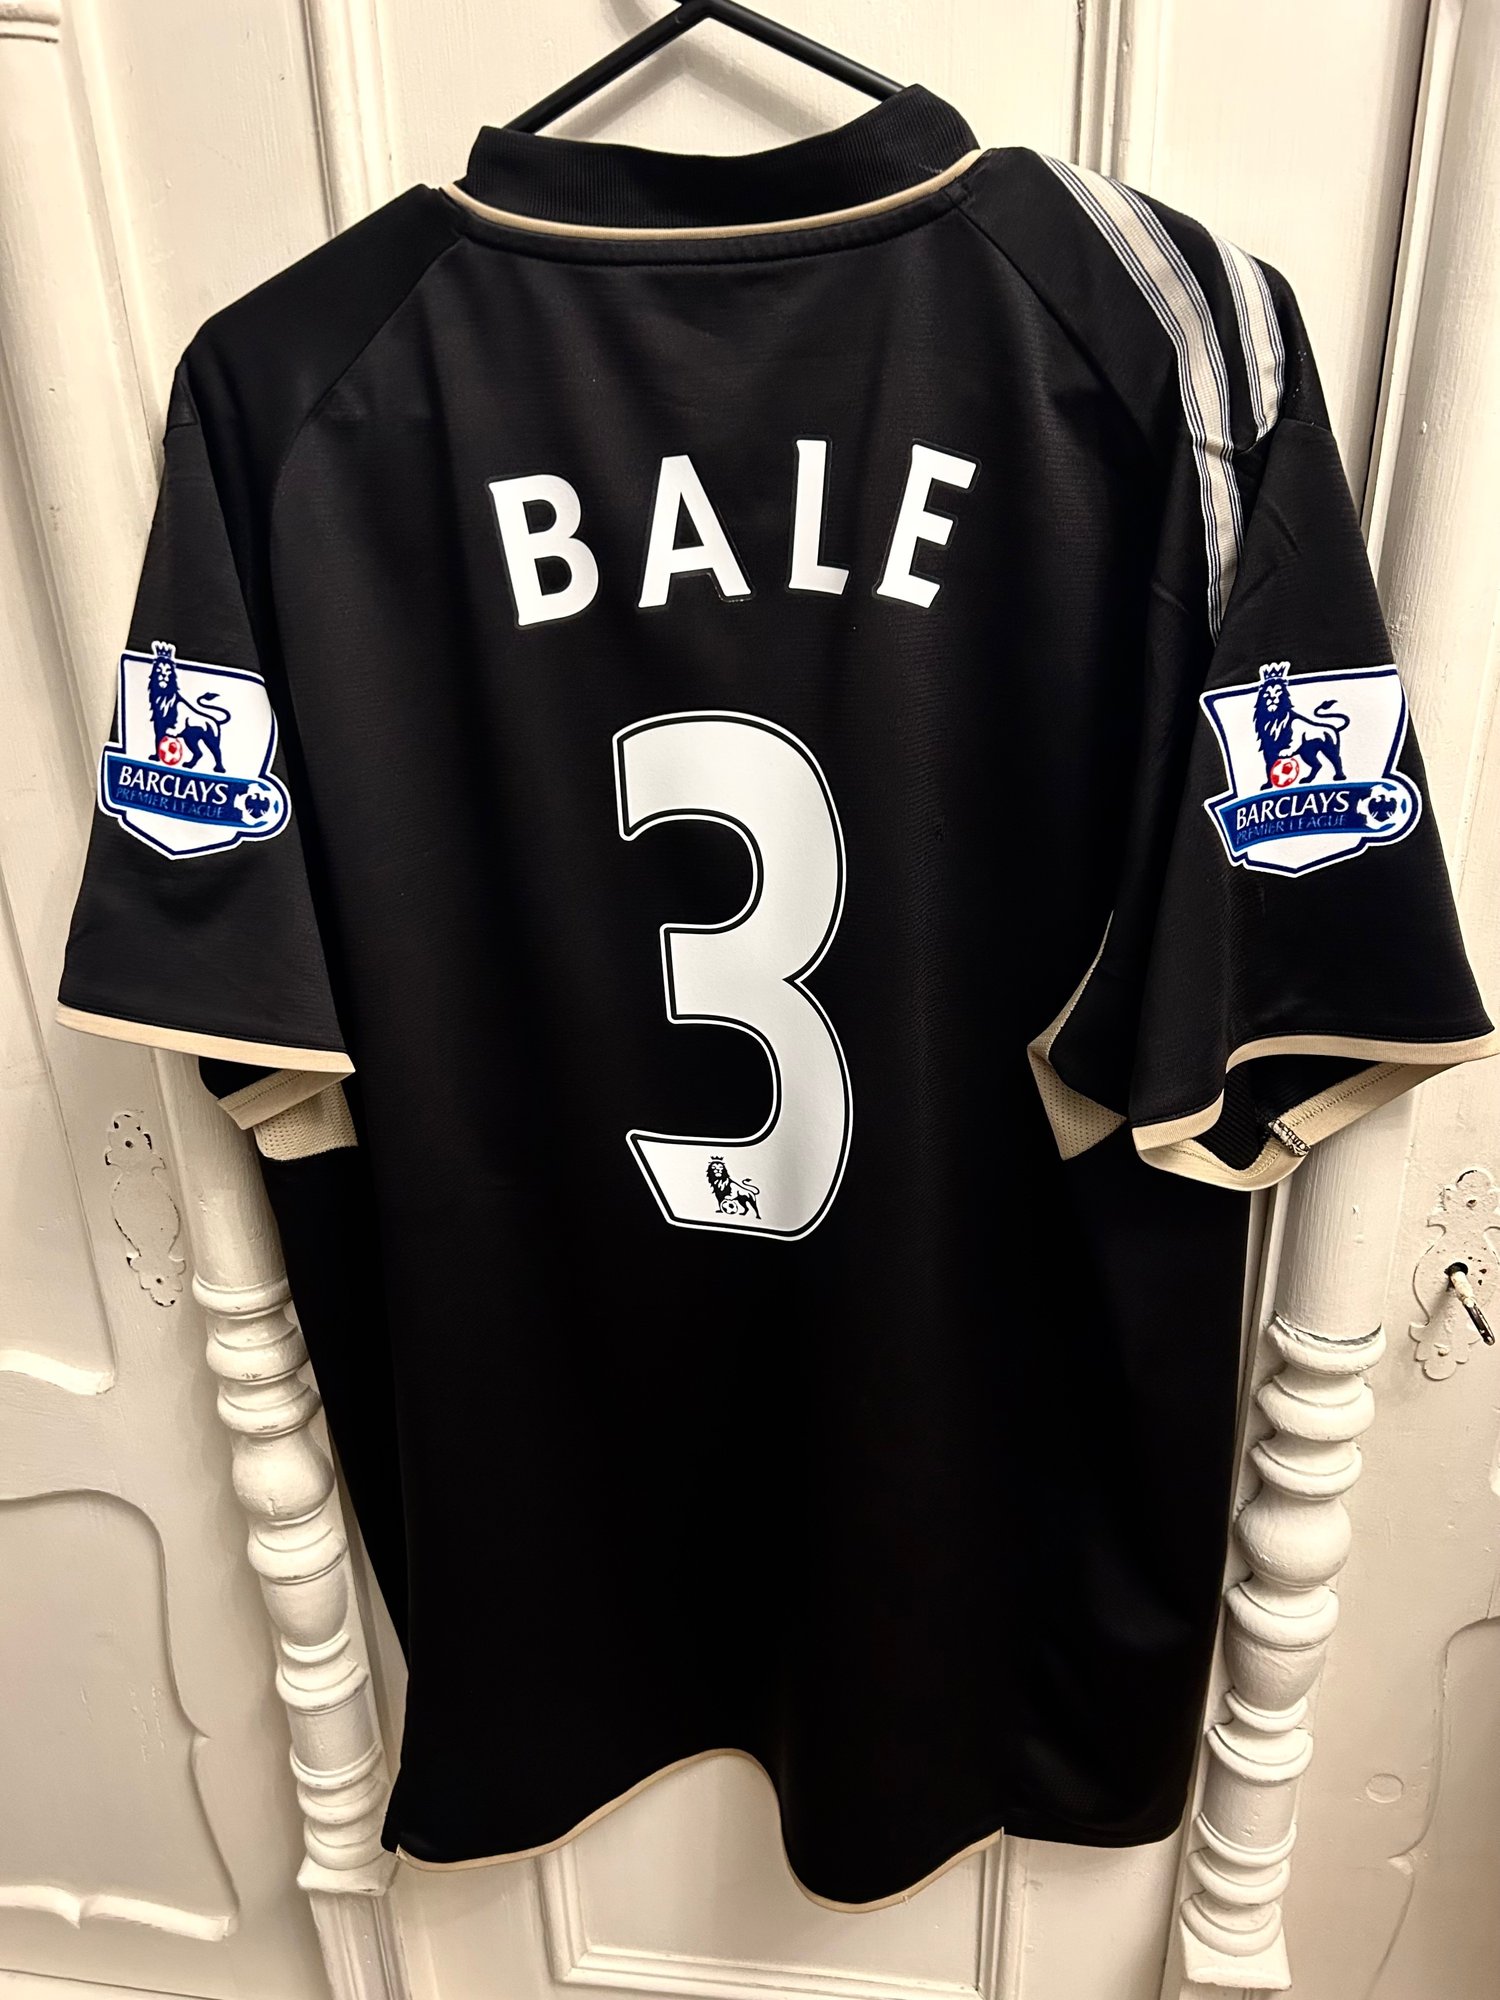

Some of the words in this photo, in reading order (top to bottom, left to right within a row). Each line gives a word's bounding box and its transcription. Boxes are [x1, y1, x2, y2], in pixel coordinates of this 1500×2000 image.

[488, 439, 978, 627] BALE
[116, 788, 168, 809] PREMIER
[118, 765, 229, 805] BARCLAYS
[1236, 791, 1350, 831] BARCLAYS
[1236, 819, 1285, 844] PREMIER
[611, 709, 853, 1241] 3
